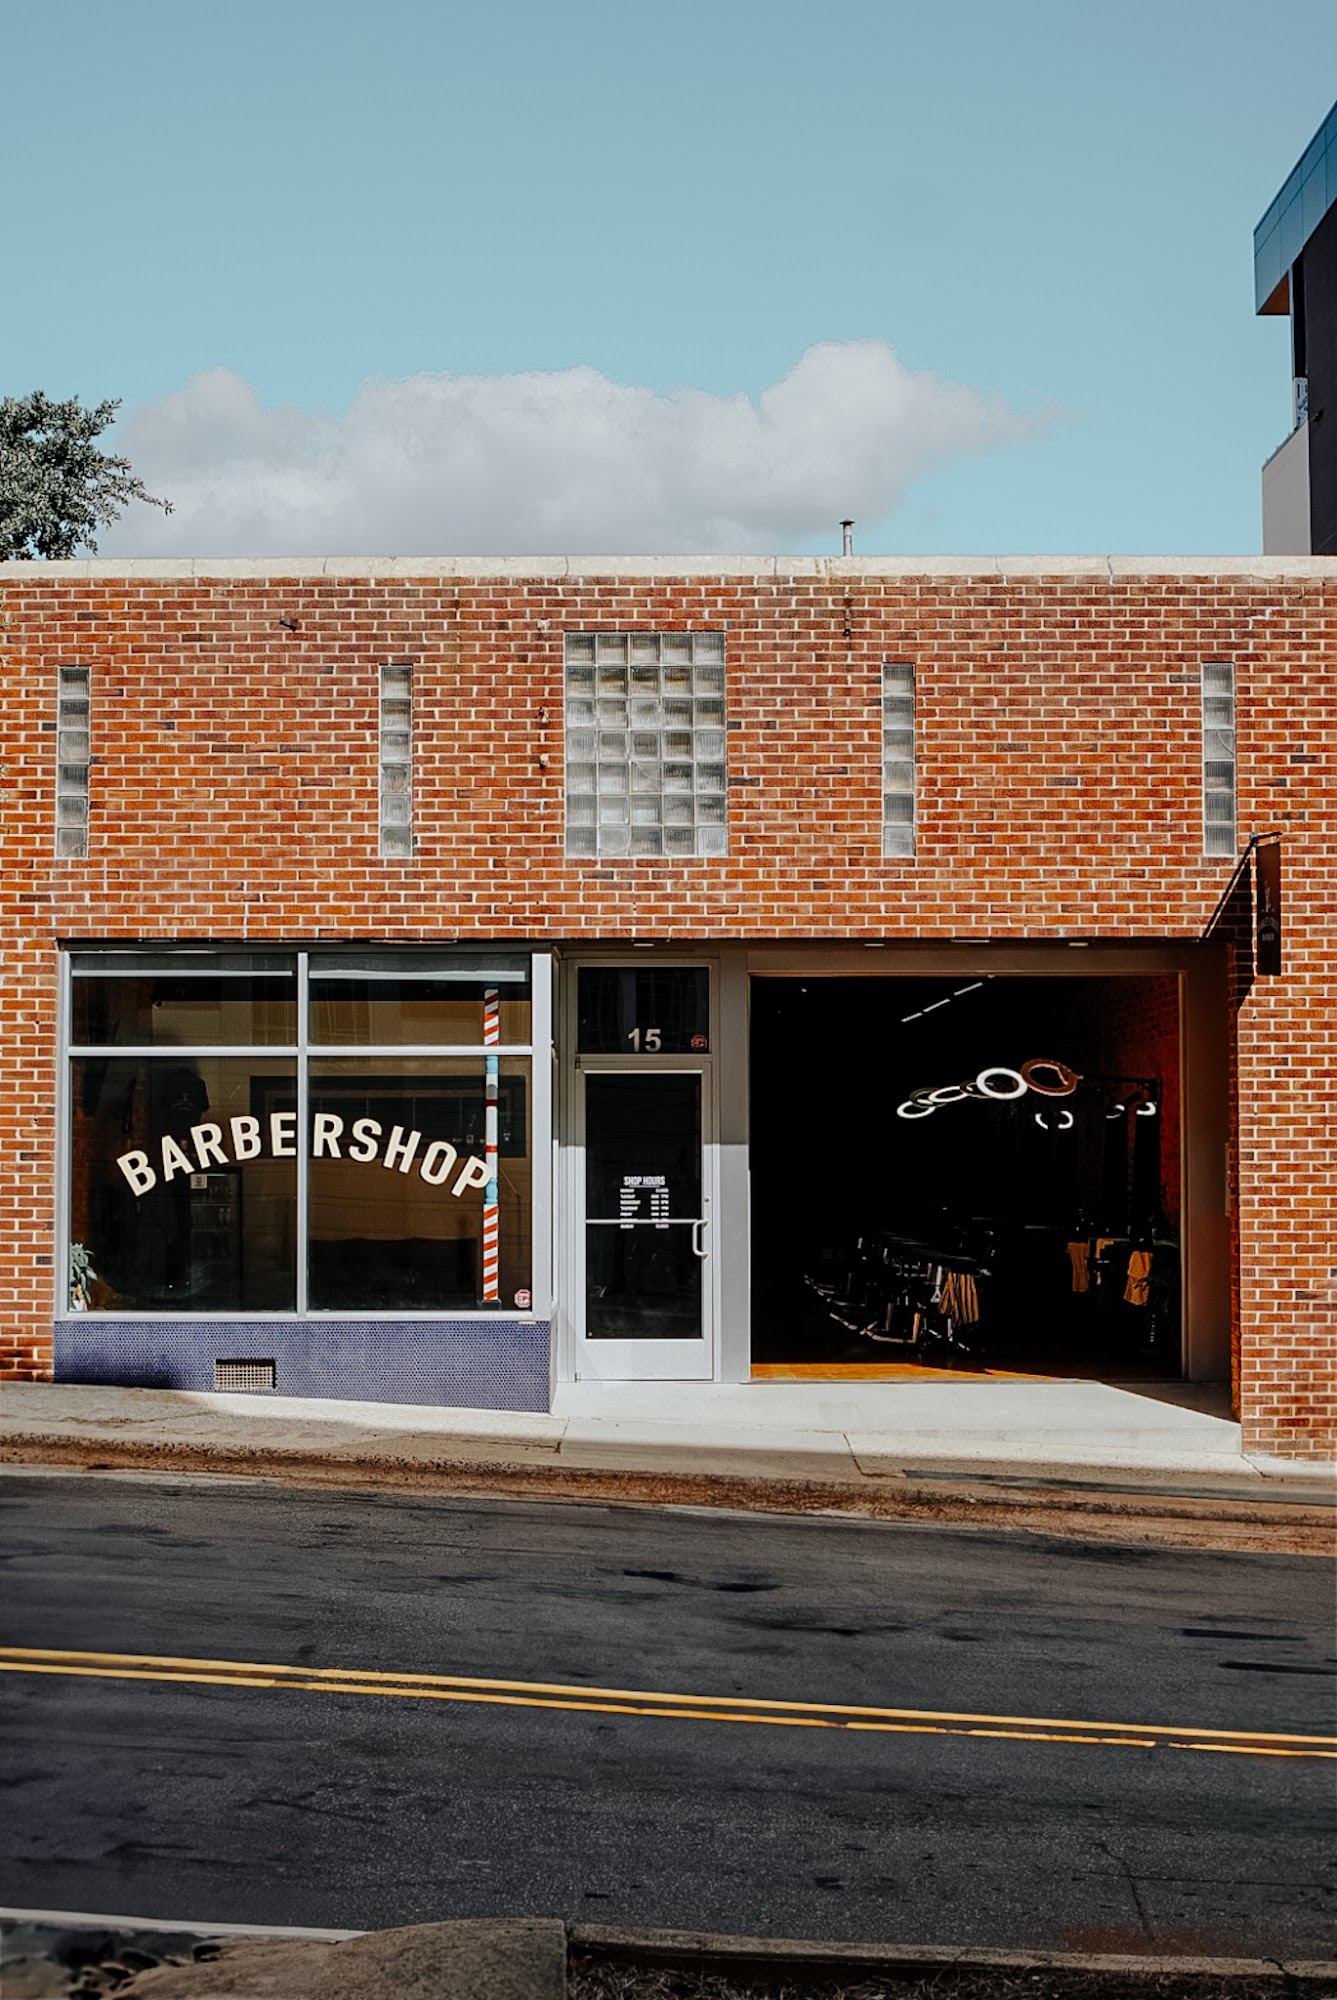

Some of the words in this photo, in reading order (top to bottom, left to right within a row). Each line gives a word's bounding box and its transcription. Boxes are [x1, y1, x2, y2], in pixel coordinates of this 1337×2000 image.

[628, 1028, 661, 1052] 15
[117, 1113, 492, 1198] BARBERSHOP
[623, 1175, 642, 1186] SHOP
[642, 1175, 666, 1186] HOURS
